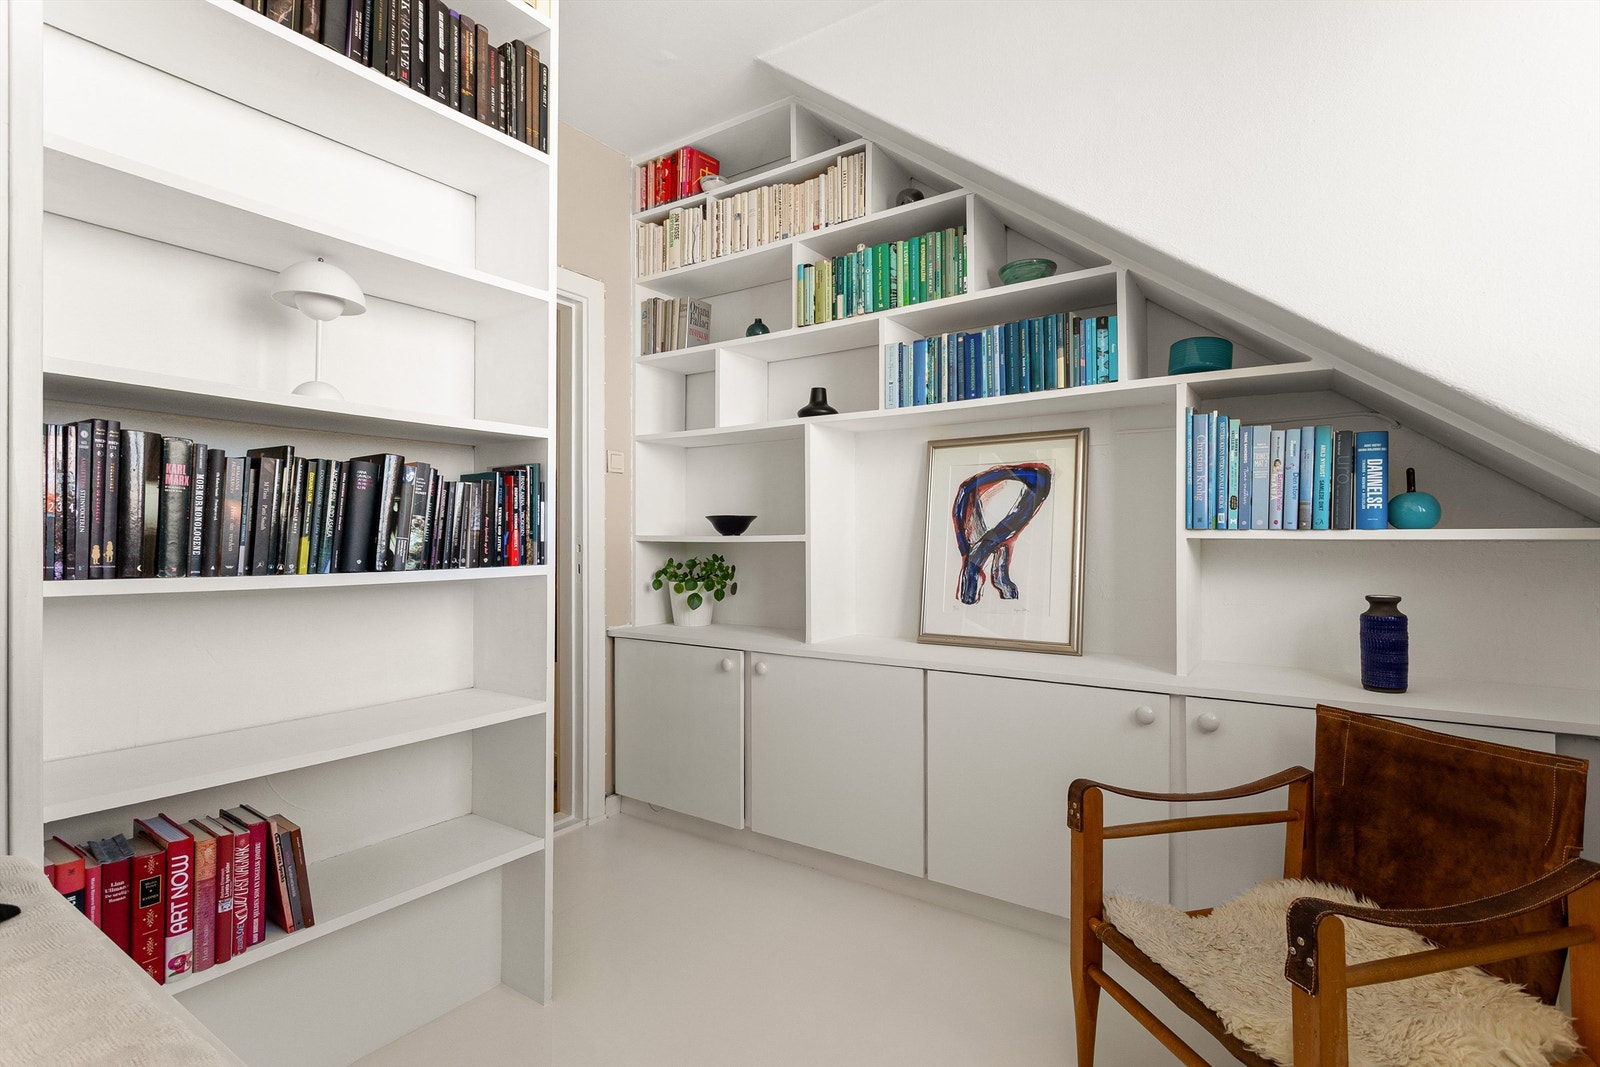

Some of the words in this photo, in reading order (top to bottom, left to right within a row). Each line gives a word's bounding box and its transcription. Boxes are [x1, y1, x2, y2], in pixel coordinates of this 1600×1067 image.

[400, 28, 409, 70] CAVE
[1196, 434, 1206, 472] Christian
[165, 463, 186, 475] KARL
[165, 473, 190, 486] MARX
[1337, 455, 1351, 484] uro
[262, 487, 270, 500] Train
[1193, 475, 1206, 501] Krohg
[1276, 473, 1284, 496] Barnets
[1366, 458, 1383, 510] DANNELSE
[47, 501, 54, 513] 2
[56, 501, 62, 512] 3
[68, 501, 75, 513] 4
[192, 473, 205, 556] MORMORMONOLOGENE
[170, 854, 189, 899] NOW
[169, 901, 188, 934] ART
